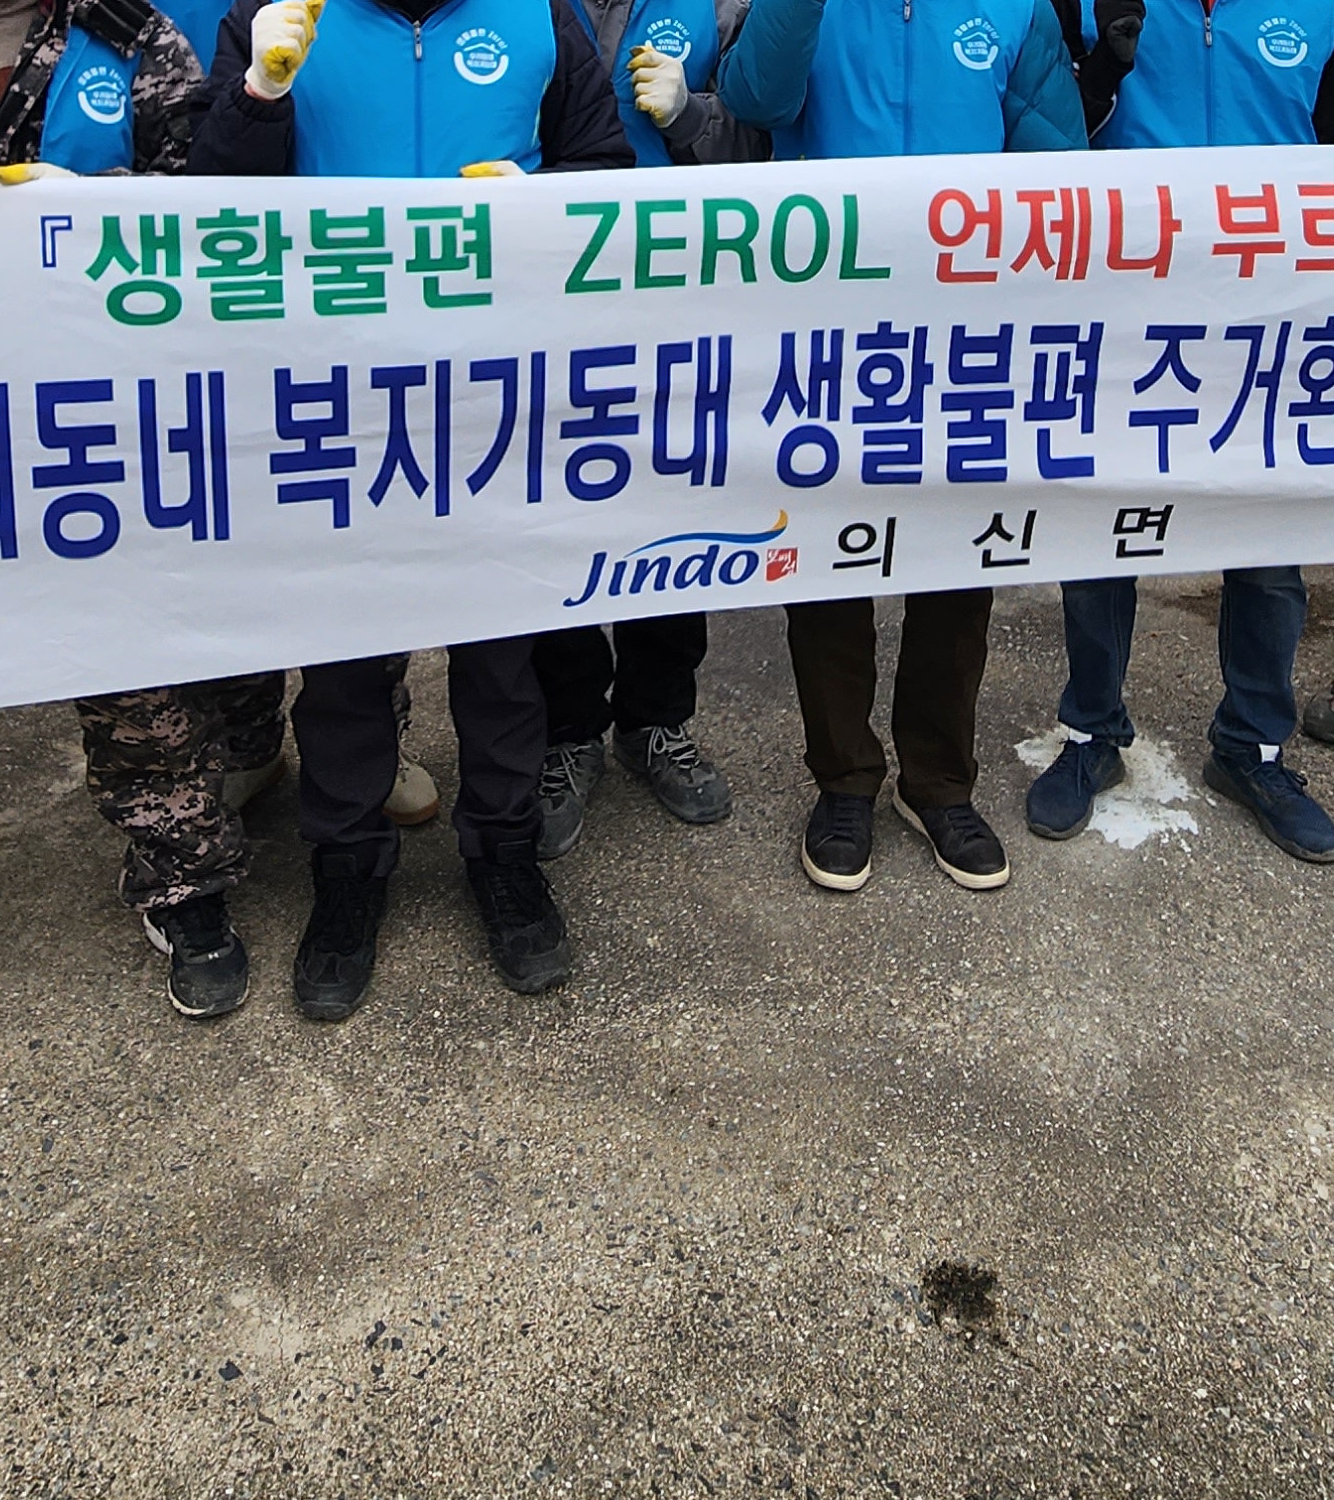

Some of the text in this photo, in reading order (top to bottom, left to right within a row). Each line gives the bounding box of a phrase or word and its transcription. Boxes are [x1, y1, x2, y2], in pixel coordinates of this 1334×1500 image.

[564, 193, 892, 295] ZEROL
[927, 185, 1183, 284] 언제나
[269, 334, 732, 529] 복지기동대
[761, 320, 1106, 489] 생활불편
[562, 543, 760, 608] Jindo
